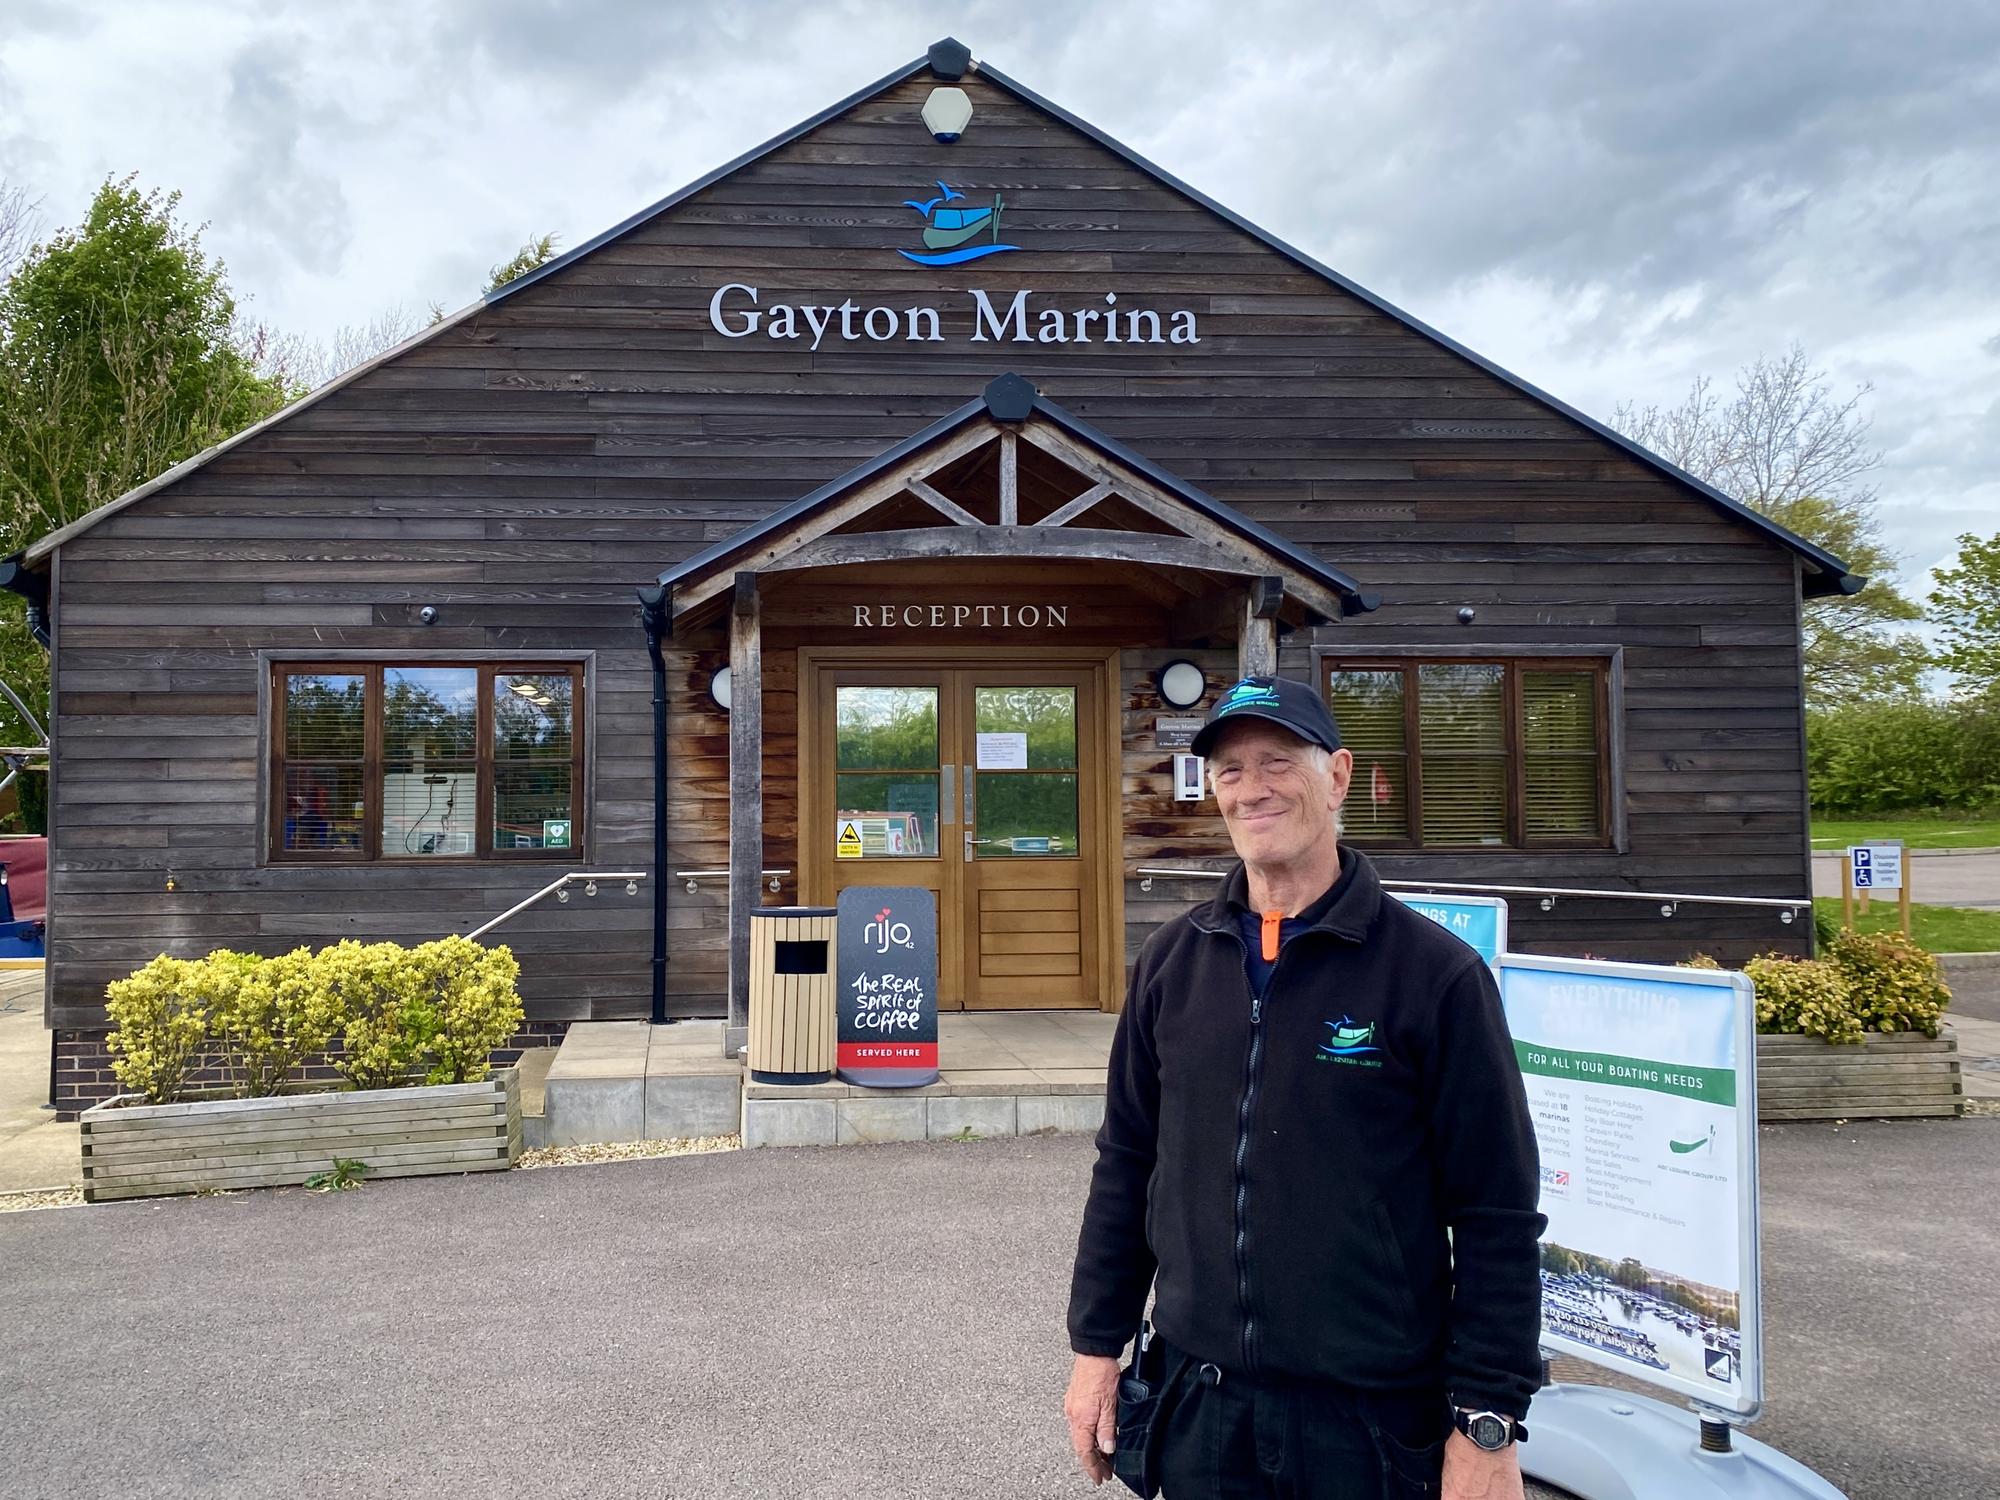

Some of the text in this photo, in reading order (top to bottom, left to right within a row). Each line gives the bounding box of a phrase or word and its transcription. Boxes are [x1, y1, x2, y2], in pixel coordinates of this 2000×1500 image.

[708, 282, 1201, 351] Gayton Marina
[852, 605, 1068, 628] RECEPTION
[1856, 850, 1869, 865] P
[1452, 912, 1472, 929] AT
[864, 919, 912, 954] rijo
[904, 941, 915, 949] 42
[851, 971, 879, 994] The
[906, 992, 924, 1012] of
[1549, 984, 1681, 1016] EVERYTHING
[856, 1048, 921, 1057] SERVED HERE
[1527, 1052, 1704, 1089] FOR ALL YOUR BOATING NEEDS
[1539, 1111, 1570, 1123] marinas
[1560, 1103, 1568, 1111] 18
